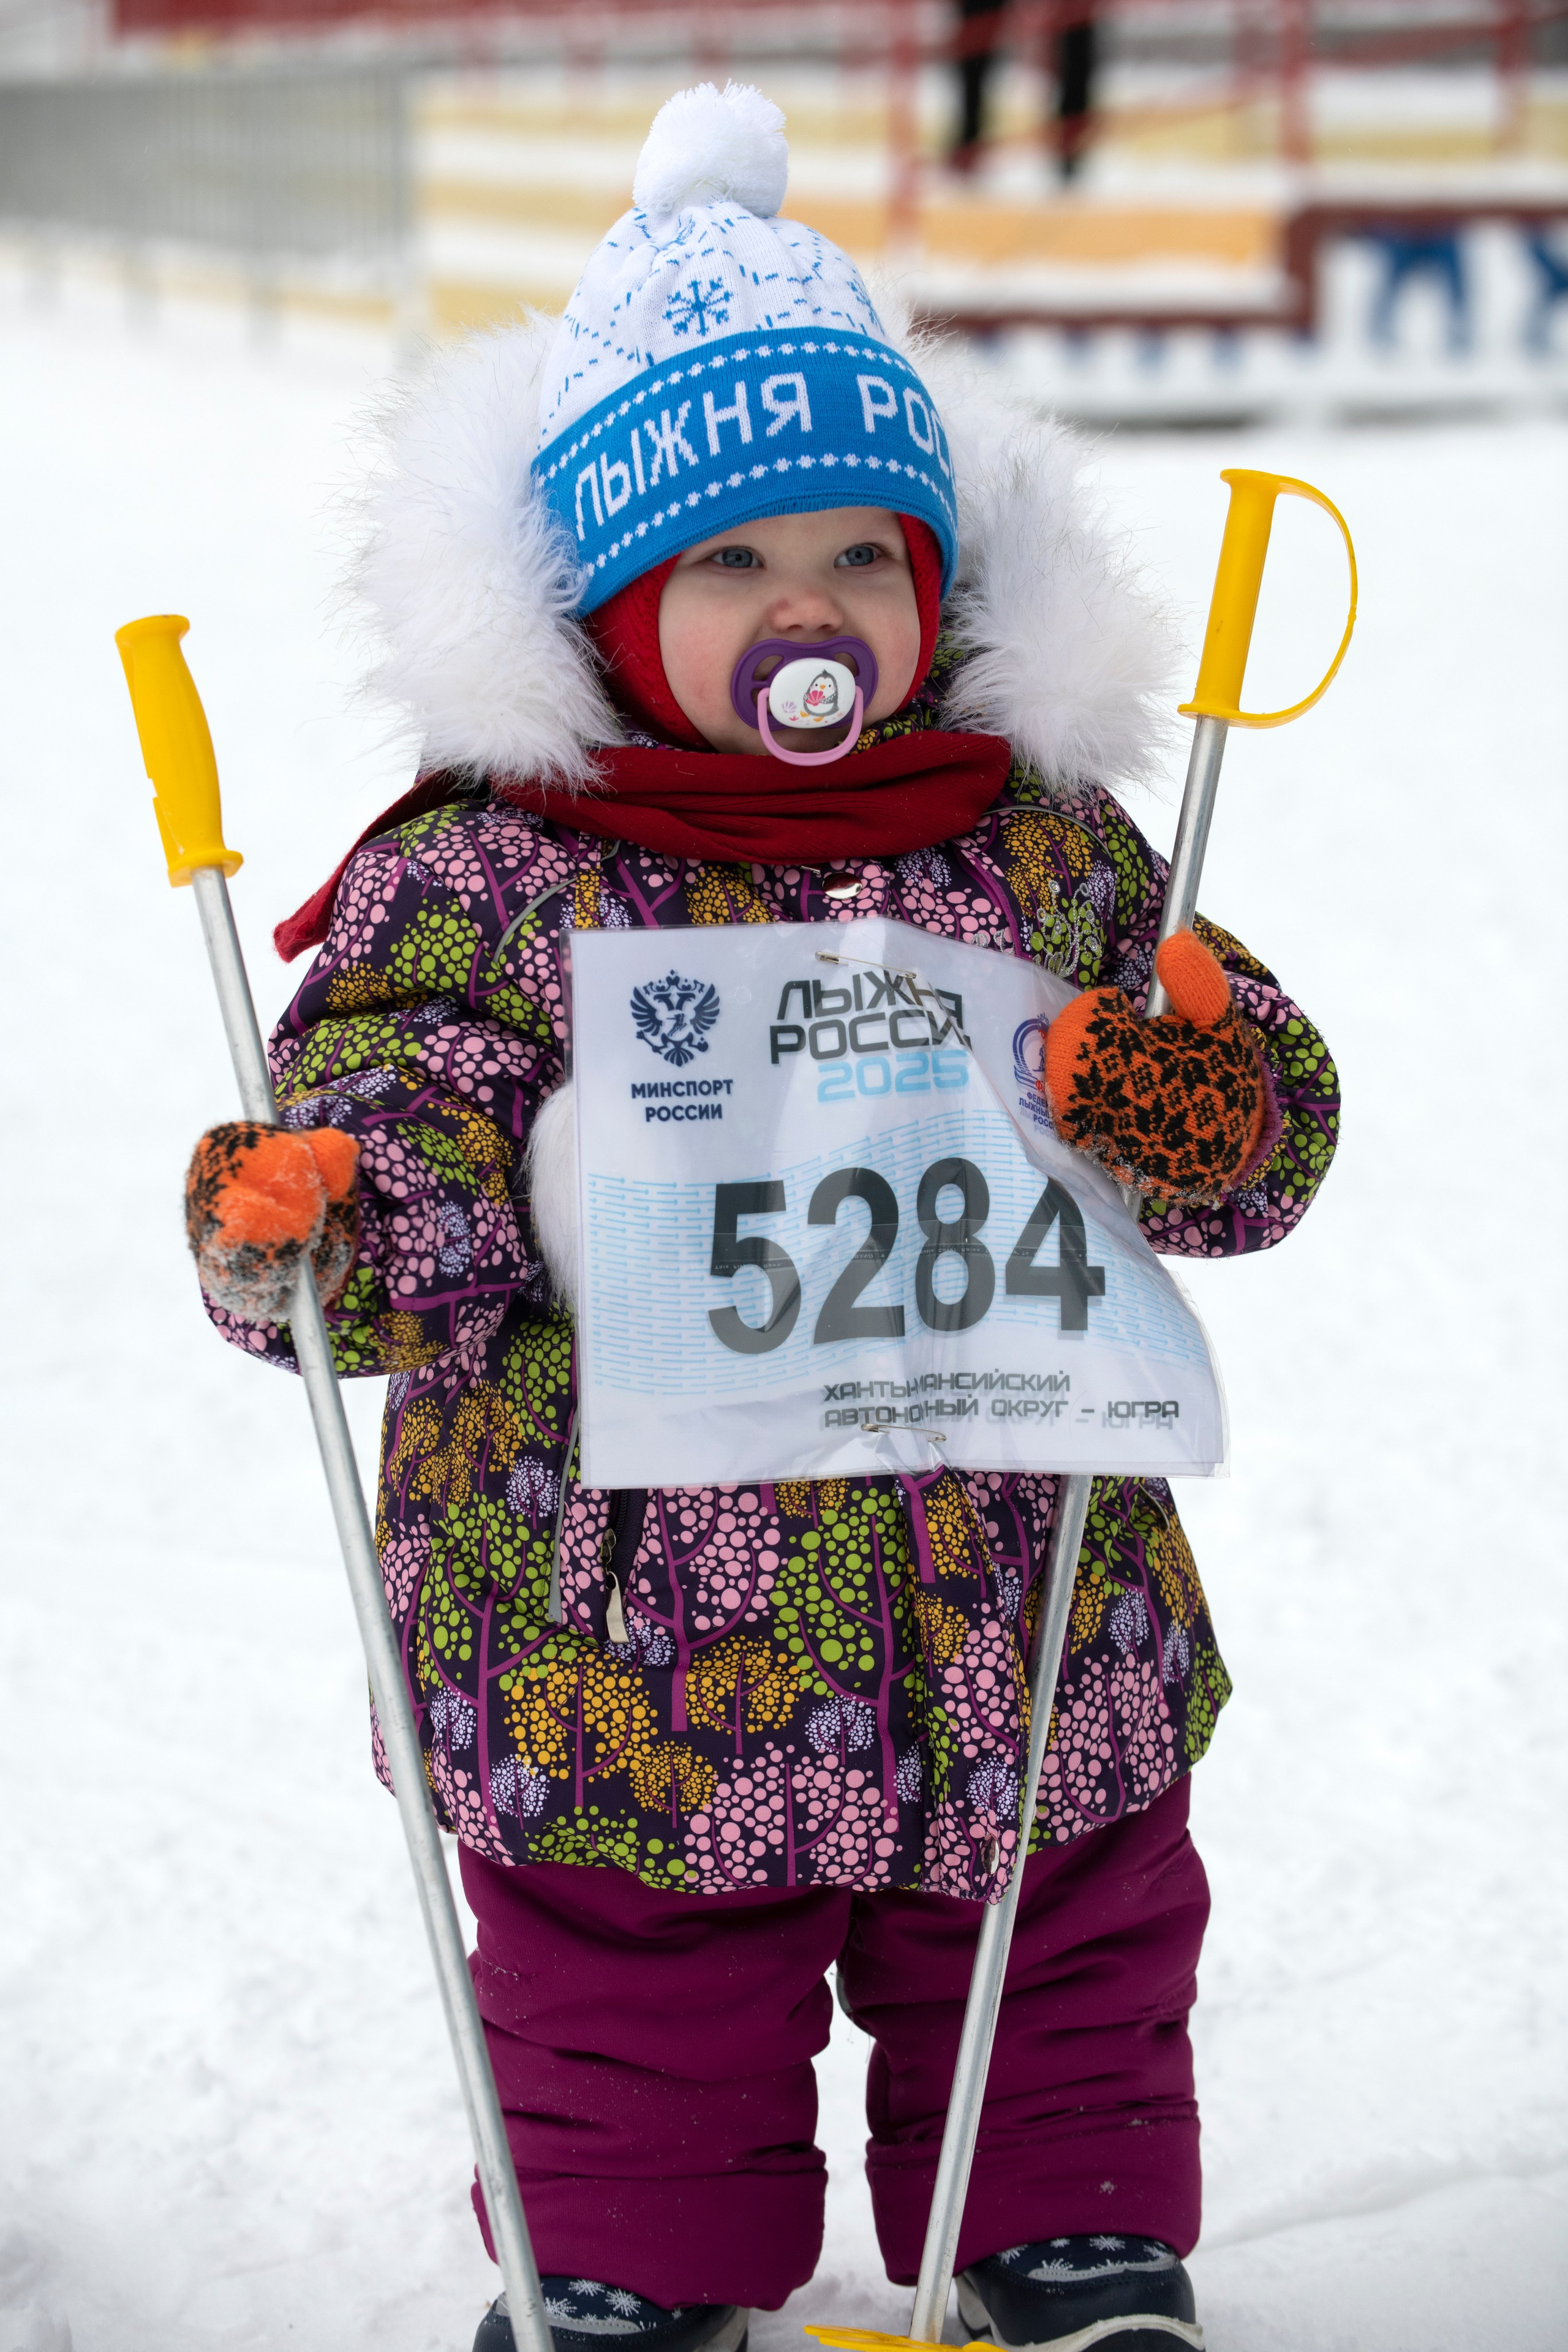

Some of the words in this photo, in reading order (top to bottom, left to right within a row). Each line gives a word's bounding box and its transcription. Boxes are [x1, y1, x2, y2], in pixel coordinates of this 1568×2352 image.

[575, 371, 813, 541] ЛЫЖНЯ
[856, 373, 954, 485] РОС
[816, 1049, 970, 1103] 2025
[631, 1079, 734, 1099] МИНСПОРТ
[645, 1103, 723, 1122] РОССИИ
[1019, 1097, 1050, 1118] ЛЫЖНЫ
[1033, 1114, 1055, 1131] РОСС
[707, 1157, 1106, 1355] 5284
[990, 1399, 1069, 1417] ОКРУГ
[1107, 1400, 1180, 1419] ЮГРА
